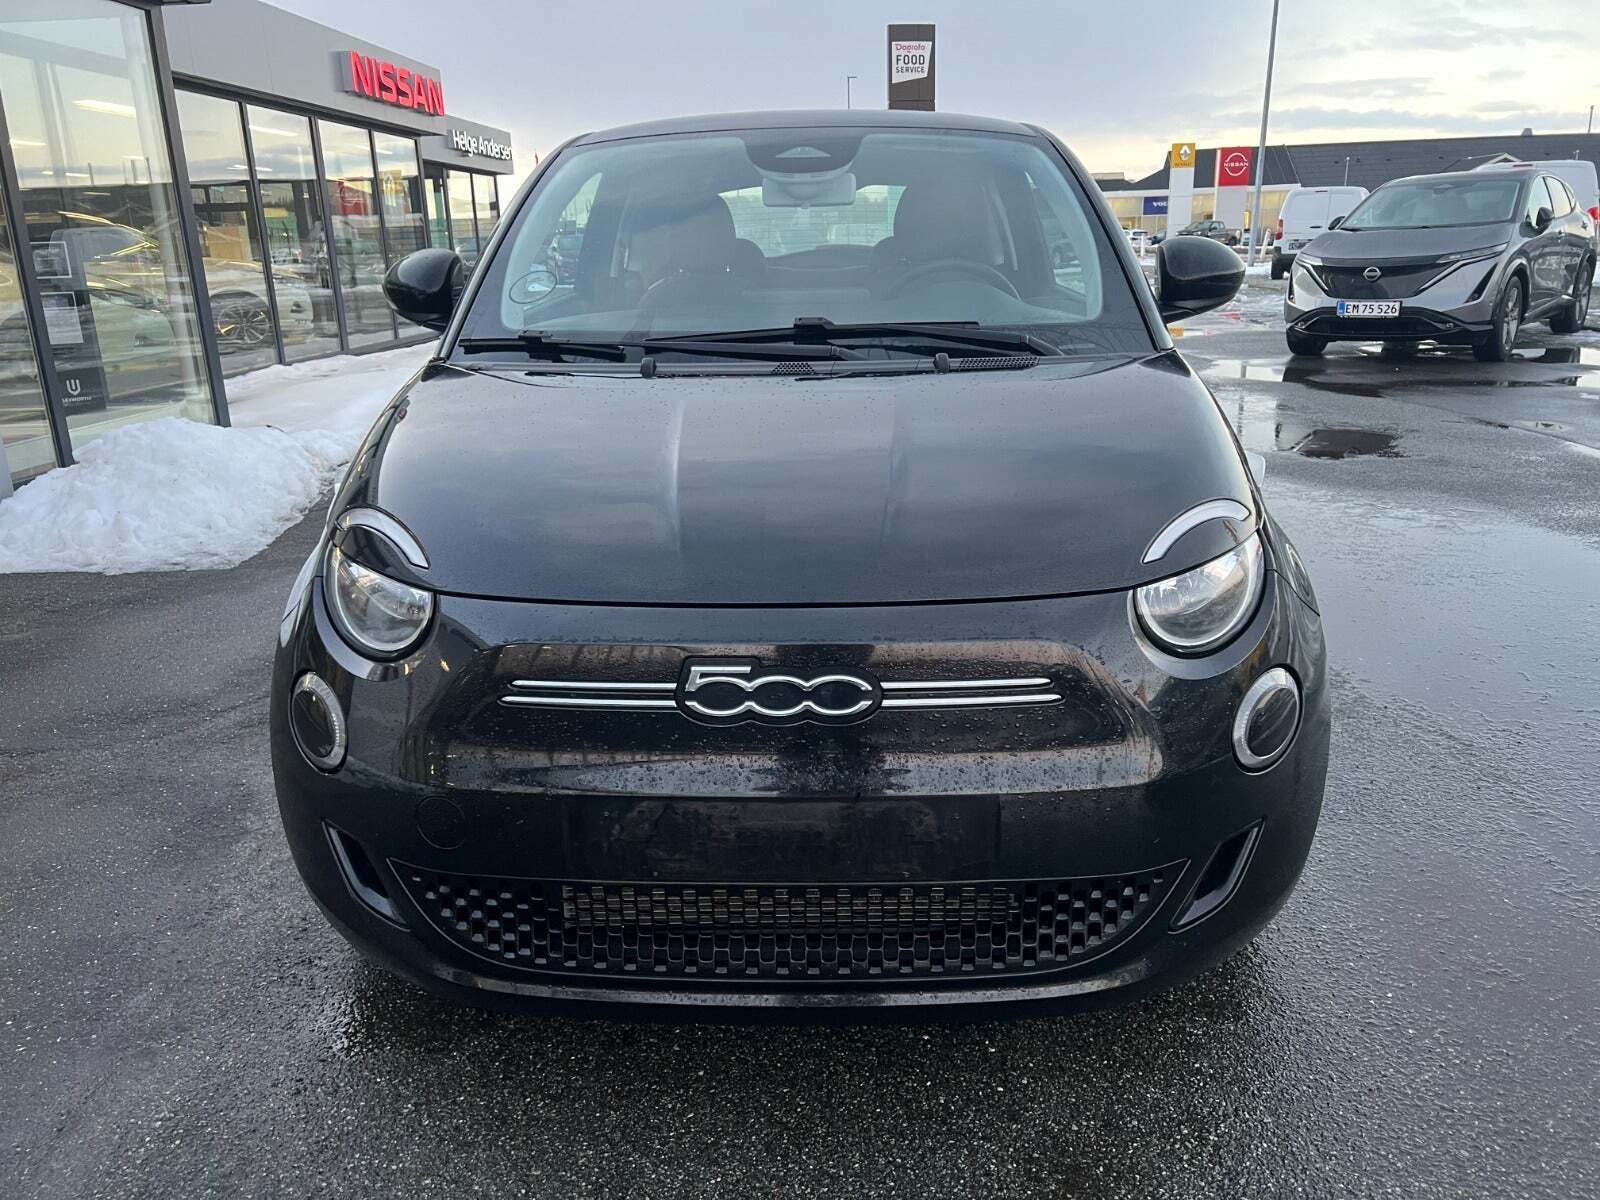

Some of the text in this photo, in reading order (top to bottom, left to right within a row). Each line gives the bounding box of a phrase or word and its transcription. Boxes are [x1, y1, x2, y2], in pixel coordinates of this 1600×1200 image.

[896, 54, 925, 65] FOOD
[895, 66, 925, 74] SERVICE
[351, 51, 445, 116] NISSAN
[452, 129, 478, 157] Helge
[1345, 303, 1397, 314] EM 75 526
[684, 666, 873, 716] 500
